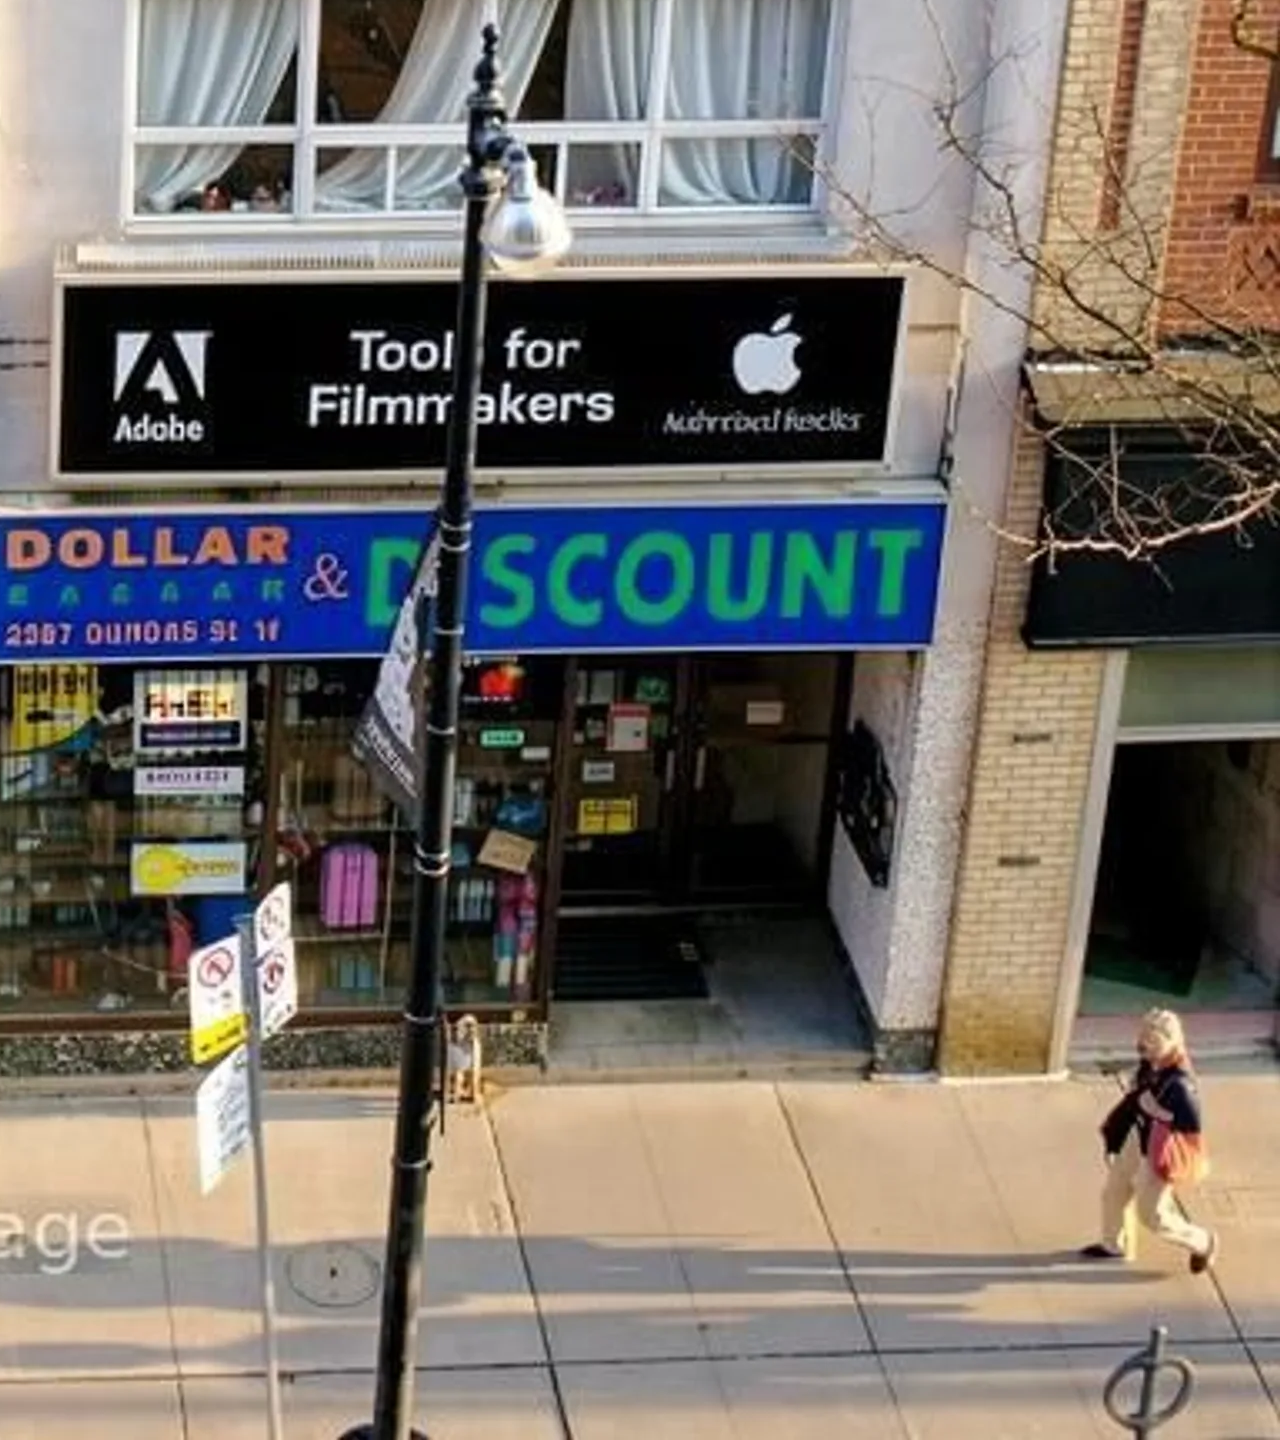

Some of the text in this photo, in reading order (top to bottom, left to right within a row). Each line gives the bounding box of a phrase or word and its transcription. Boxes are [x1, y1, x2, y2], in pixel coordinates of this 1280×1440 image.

[349, 327, 582, 372] Tool for
[114, 413, 205, 442] Adobe
[5, 525, 290, 570] DOLLAR
[366, 529, 923, 627] DSCOUNT
